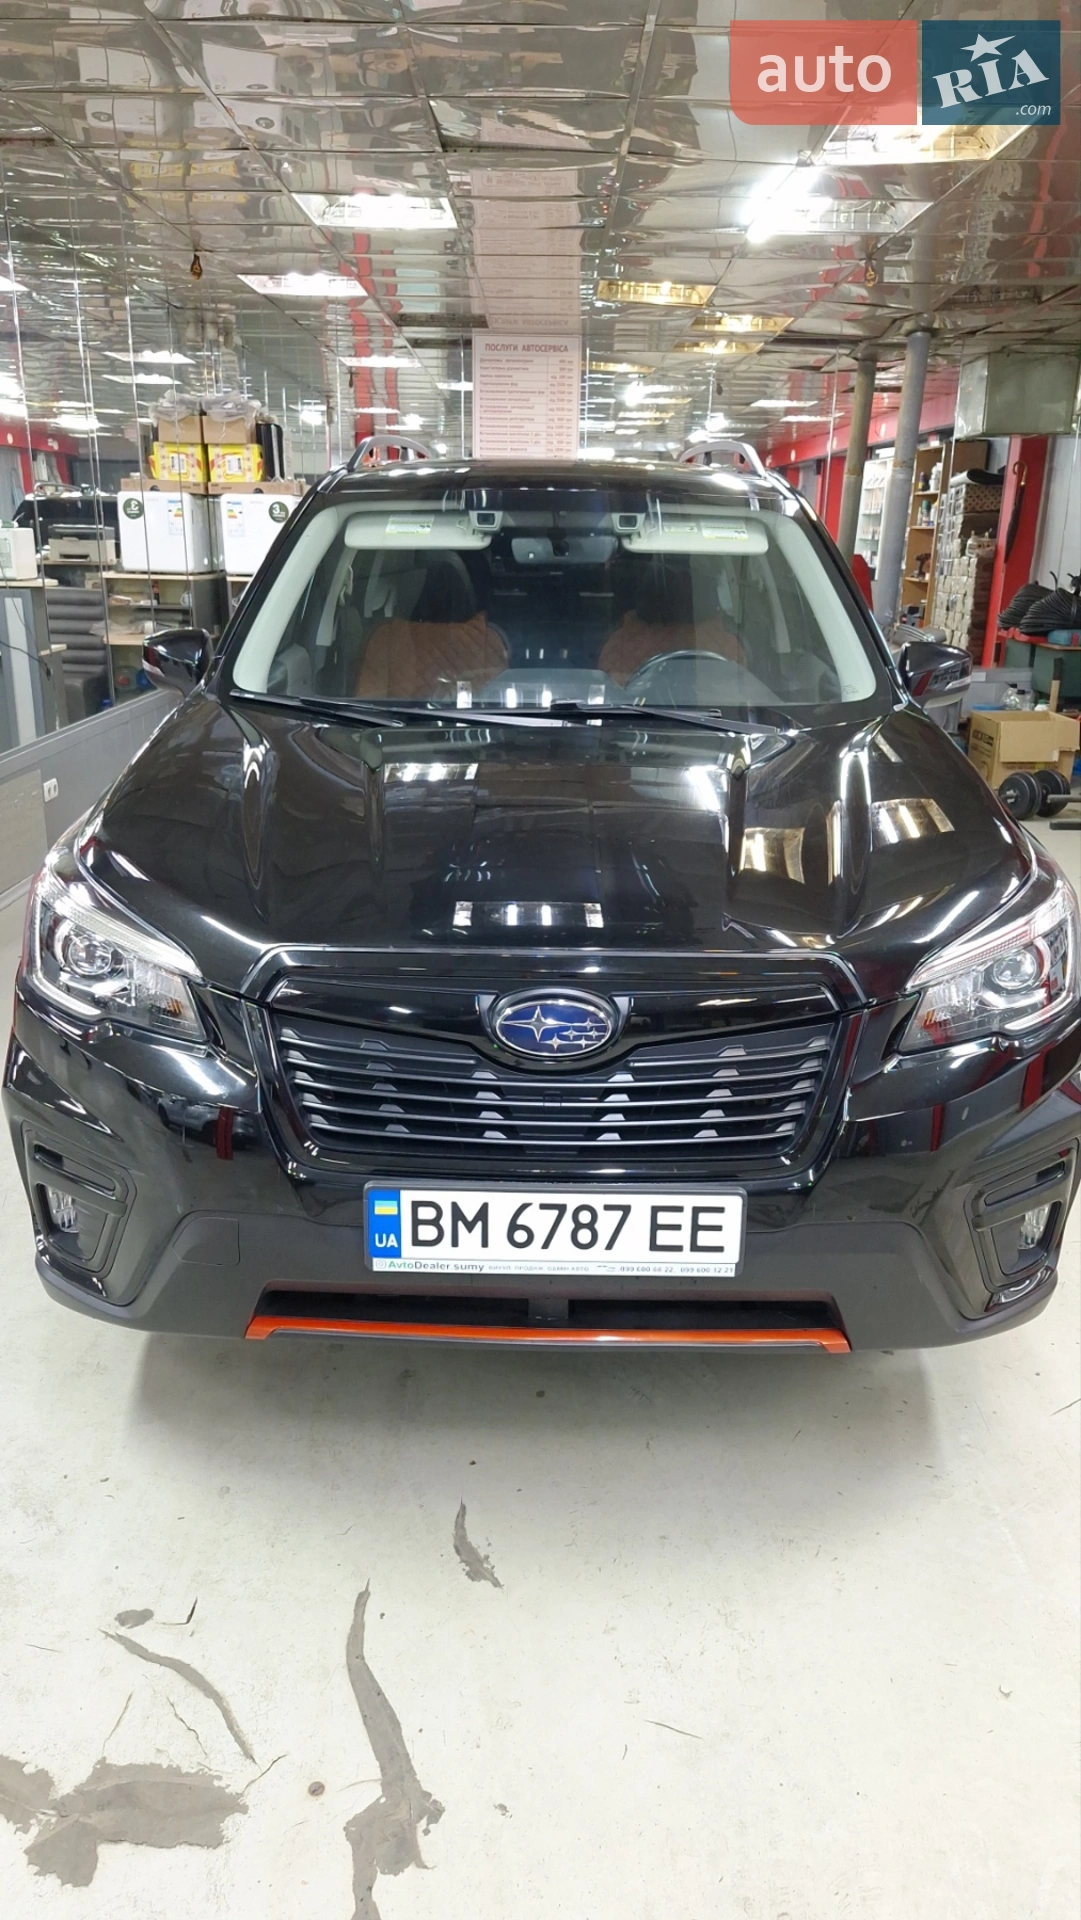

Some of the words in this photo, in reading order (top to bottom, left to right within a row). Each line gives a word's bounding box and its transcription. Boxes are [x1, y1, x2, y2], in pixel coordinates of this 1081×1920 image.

[484, 343, 518, 352] ПОСЛУГИ
[522, 344, 568, 352] АВТОСЕРВІСА
[272, 504, 280, 514] 3
[410, 1200, 489, 1248] BM
[506, 1202, 632, 1250] 6787
[648, 1205, 726, 1253] EE
[374, 1233, 398, 1248] UA
